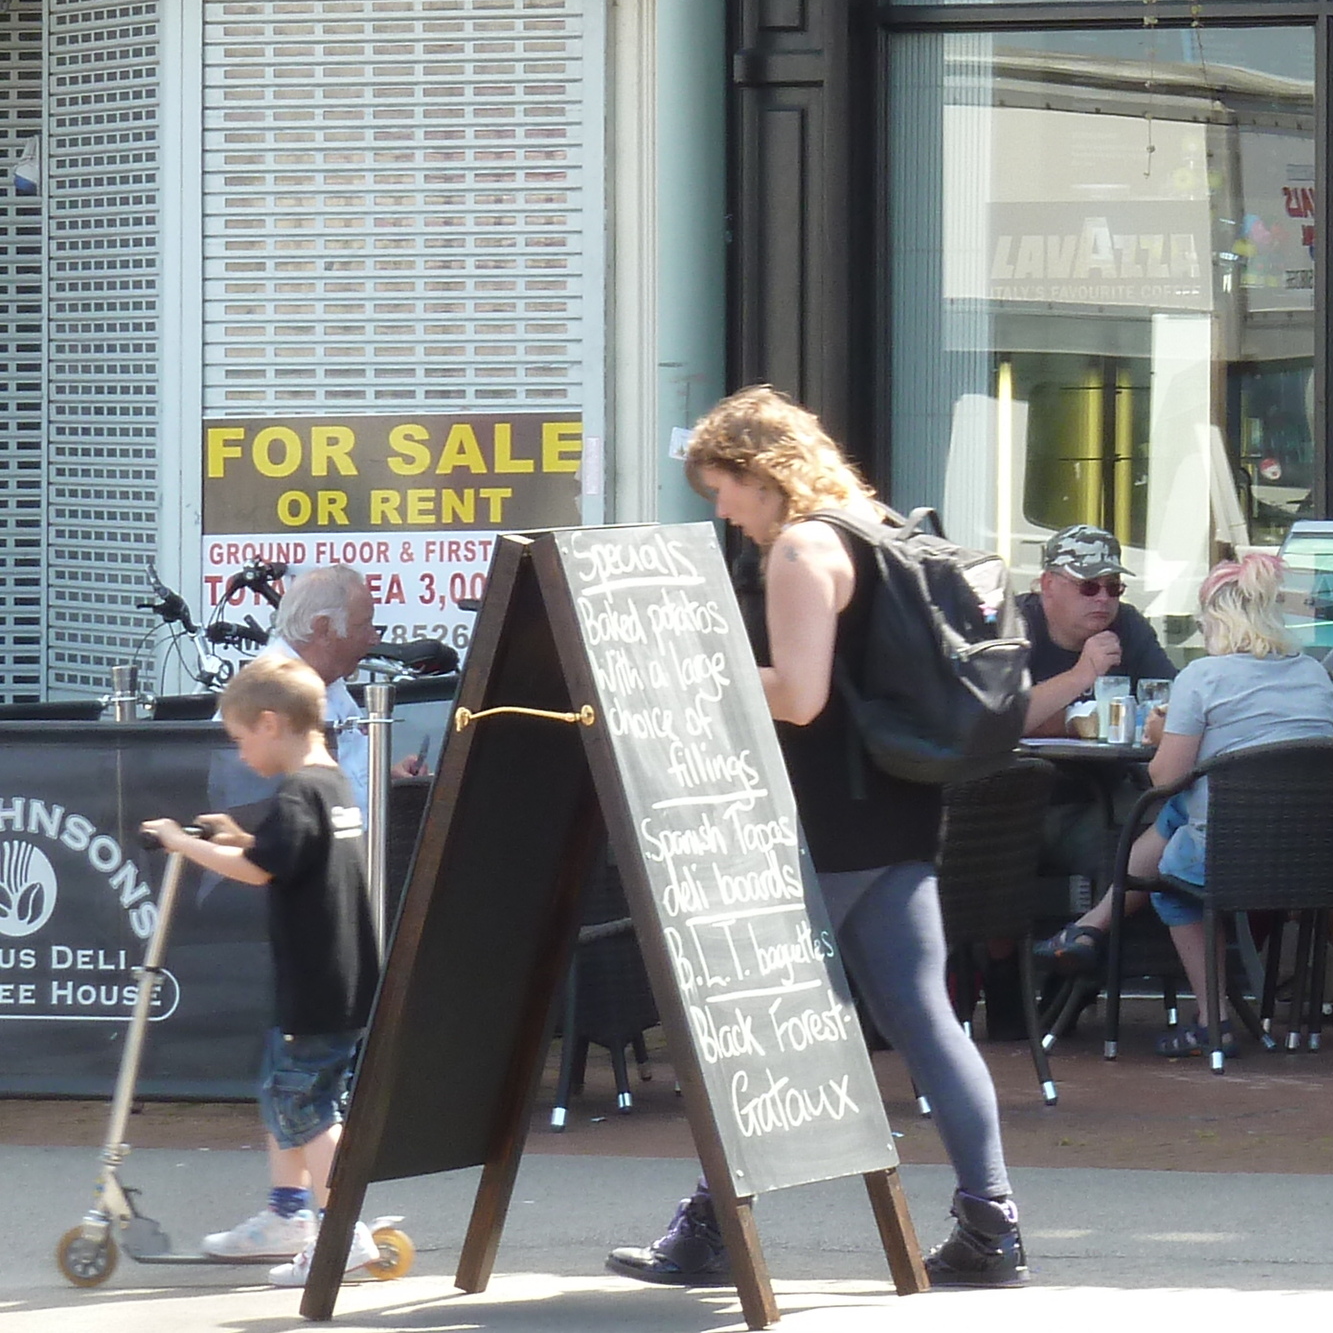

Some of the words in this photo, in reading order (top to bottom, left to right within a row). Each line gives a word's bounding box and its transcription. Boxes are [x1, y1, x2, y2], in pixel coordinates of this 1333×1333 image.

[990, 216, 1200, 280] LAVAZZA
[990, 285, 1045, 298] ITALY'S
[1052, 286, 1138, 300] FAVOURITE
[206, 425, 360, 479] FOR
[387, 421, 583, 477] SALE
[277, 490, 350, 527] OR
[370, 487, 513, 525] RENT
[209, 542, 307, 566] GROUND
[316, 541, 390, 564] FLOOR
[399, 541, 415, 562] &
[425, 540, 493, 563] FIRST
[571, 533, 699, 604] Specials
[577, 597, 648, 645] Baked
[650, 660, 670, 690] a
[608, 697, 680, 742] choice
[685, 691, 714, 740] of
[667, 740, 761, 809] fillings
[641, 812, 728, 870] Spanish
[663, 862, 710, 917] deli
[713, 850, 804, 905] boards
[51, 945, 127, 971] DELI
[51, 980, 162, 1006] HOUSE
[688, 1004, 766, 1064] Black
